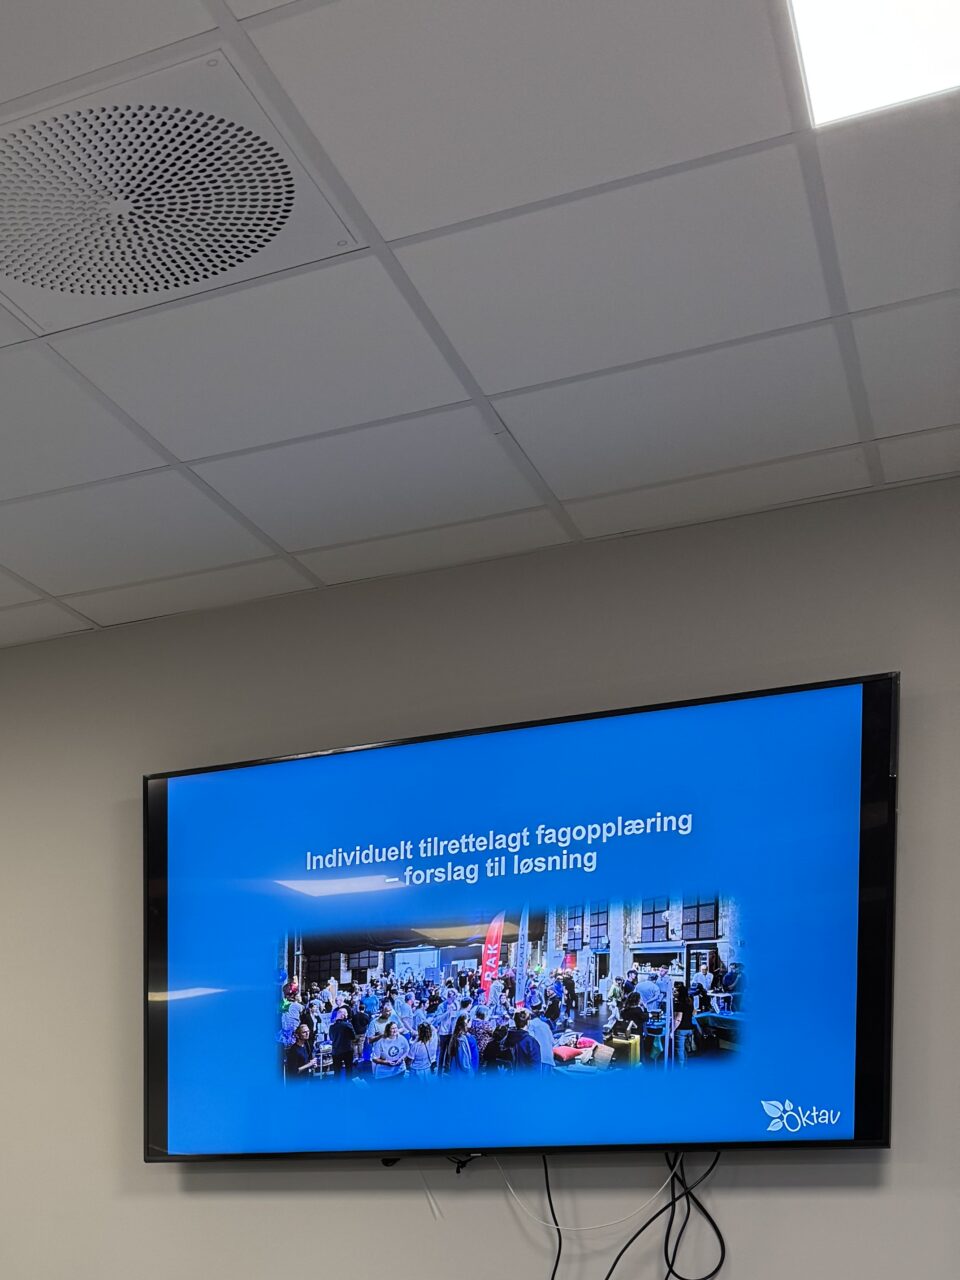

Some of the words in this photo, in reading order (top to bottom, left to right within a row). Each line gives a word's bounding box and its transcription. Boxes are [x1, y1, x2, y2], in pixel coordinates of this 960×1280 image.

[306, 840, 413, 871] Individuelt
[418, 827, 530, 859] tilrettelagt
[535, 812, 693, 848] fagopplæring
[403, 861, 479, 886] forslag
[485, 856, 506, 878] til
[513, 849, 597, 875] løsning
[784, 1106, 841, 1132] Oktav
